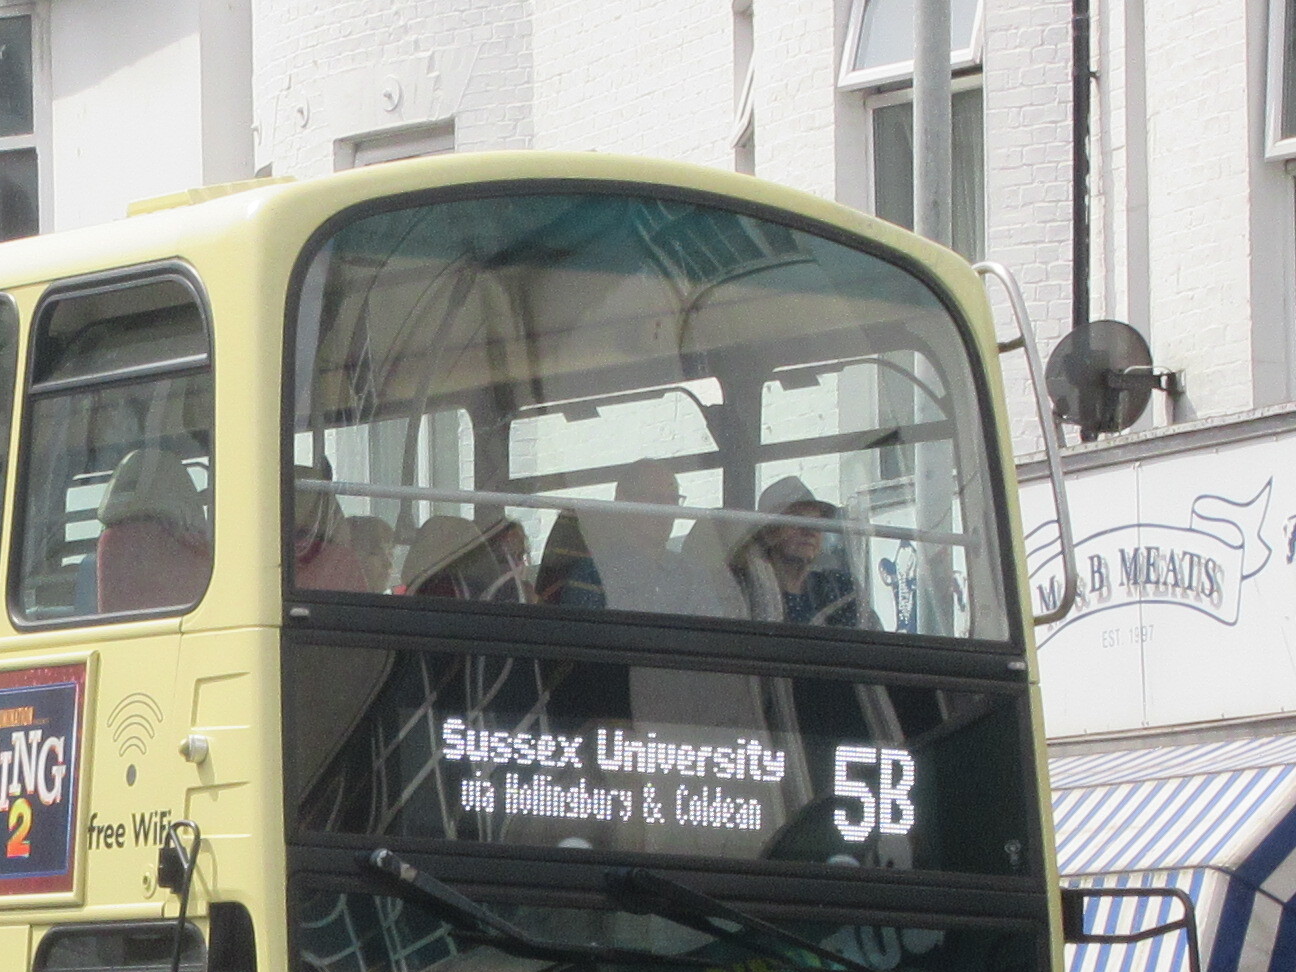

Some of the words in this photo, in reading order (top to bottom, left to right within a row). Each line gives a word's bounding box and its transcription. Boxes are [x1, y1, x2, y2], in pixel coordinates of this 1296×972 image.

[1118, 545, 1220, 603] MEATS
[1102, 629, 1125, 648] EST.
[441, 719, 584, 770] Sussex
[597, 727, 787, 784] University
[460, 771, 496, 814] via
[503, 773, 634, 824] Hollingbury
[641, 782, 666, 826] &
[675, 783, 764, 832] Coldean
[833, 744, 917, 843] 5B
[6, 797, 34, 860] 2
[87, 811, 126, 851] free
[131, 808, 172, 847] WiFi
